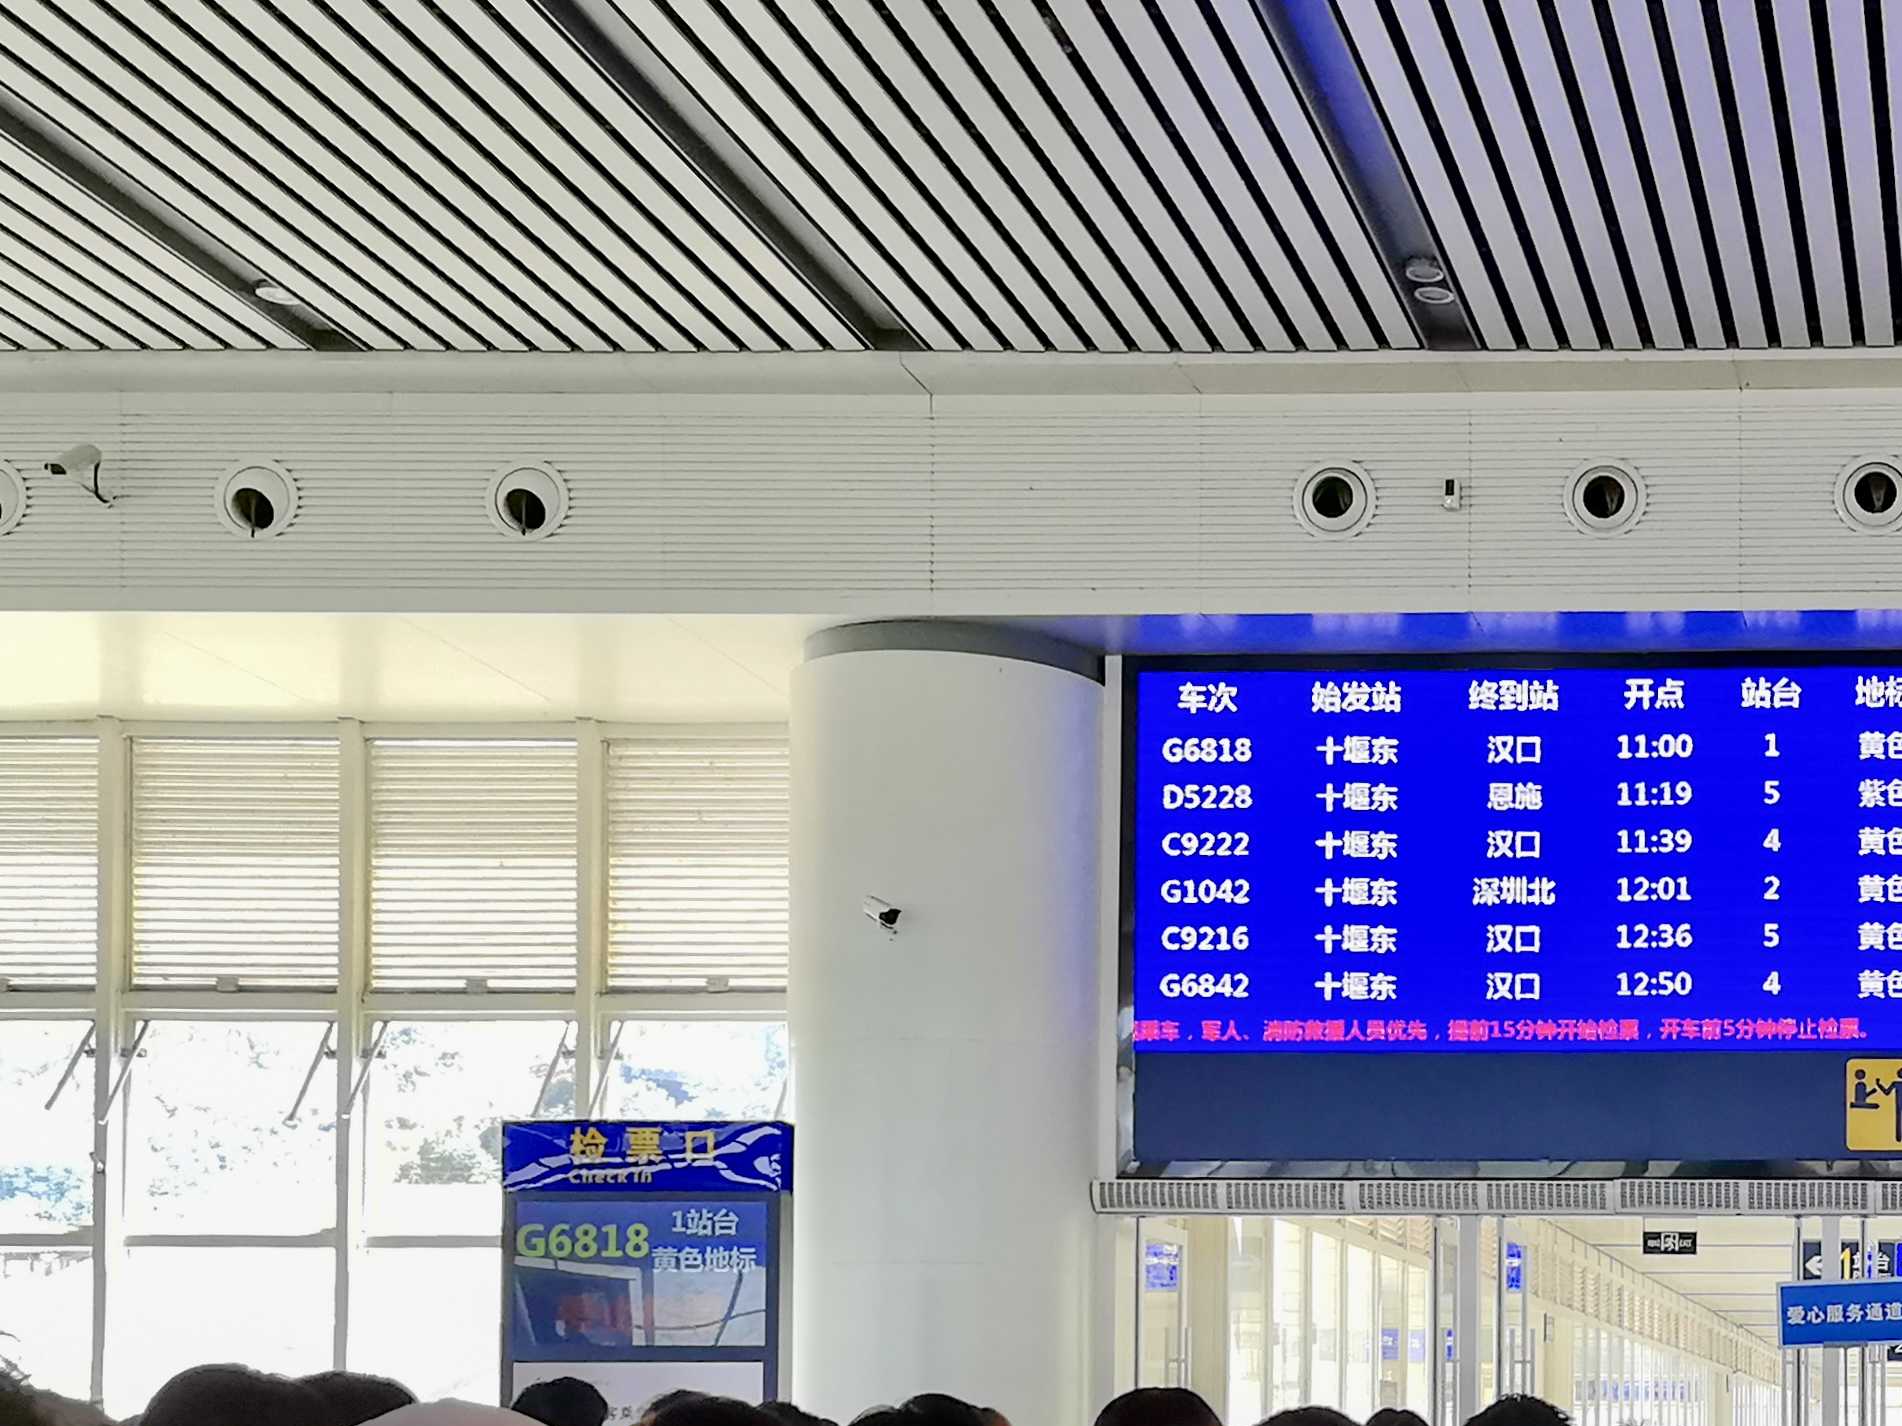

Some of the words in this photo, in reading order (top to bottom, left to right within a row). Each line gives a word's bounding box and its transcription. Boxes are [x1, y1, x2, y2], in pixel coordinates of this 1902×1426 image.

[1177, 681, 1238, 714] 车次
[1311, 680, 1402, 713] 始发站
[1468, 679, 1560, 712] 终到站
[1623, 677, 1685, 711] 开点
[1740, 676, 1802, 709] 站台
[1161, 737, 1252, 763] G6818
[1315, 735, 1400, 766] 十堰东
[1487, 735, 1542, 764] 汉口
[1616, 733, 1694, 760] 11:00
[1764, 732, 1781, 758] 1
[1162, 783, 1253, 810] D5228
[1315, 782, 1399, 813] 十堰东
[1486, 781, 1543, 811] 恩施
[1617, 780, 1693, 807] 11:19
[1763, 780, 1781, 805] 5
[1161, 831, 1250, 857] C9222
[1314, 829, 1399, 861] 十堰东
[1486, 829, 1541, 859] 汉口
[1616, 828, 1693, 854] 11:39
[1762, 828, 1782, 852] 4
[1160, 878, 1250, 905] G1042
[1314, 876, 1398, 907] 十堰东
[1472, 875, 1557, 907] 深圳北
[1616, 876, 1692, 903] 12:01
[1763, 875, 1781, 901] 2
[1161, 925, 1249, 951] C9216
[1314, 923, 1398, 954] 十堰东
[1485, 924, 1541, 953] 汉口
[1616, 922, 1693, 949] 12:36
[1763, 923, 1780, 948] 5
[1159, 972, 1249, 999] G6842
[1314, 970, 1398, 1001] 十堰东
[1485, 972, 1541, 1001] 汉口
[1616, 970, 1693, 996] 12:50
[1762, 971, 1782, 996] 4
[569, 1126, 717, 1164] 检票口
[671, 1209, 740, 1237] 1站台
[515, 1222, 651, 1259] G6818
[651, 1246, 757, 1274] 黄色地标
